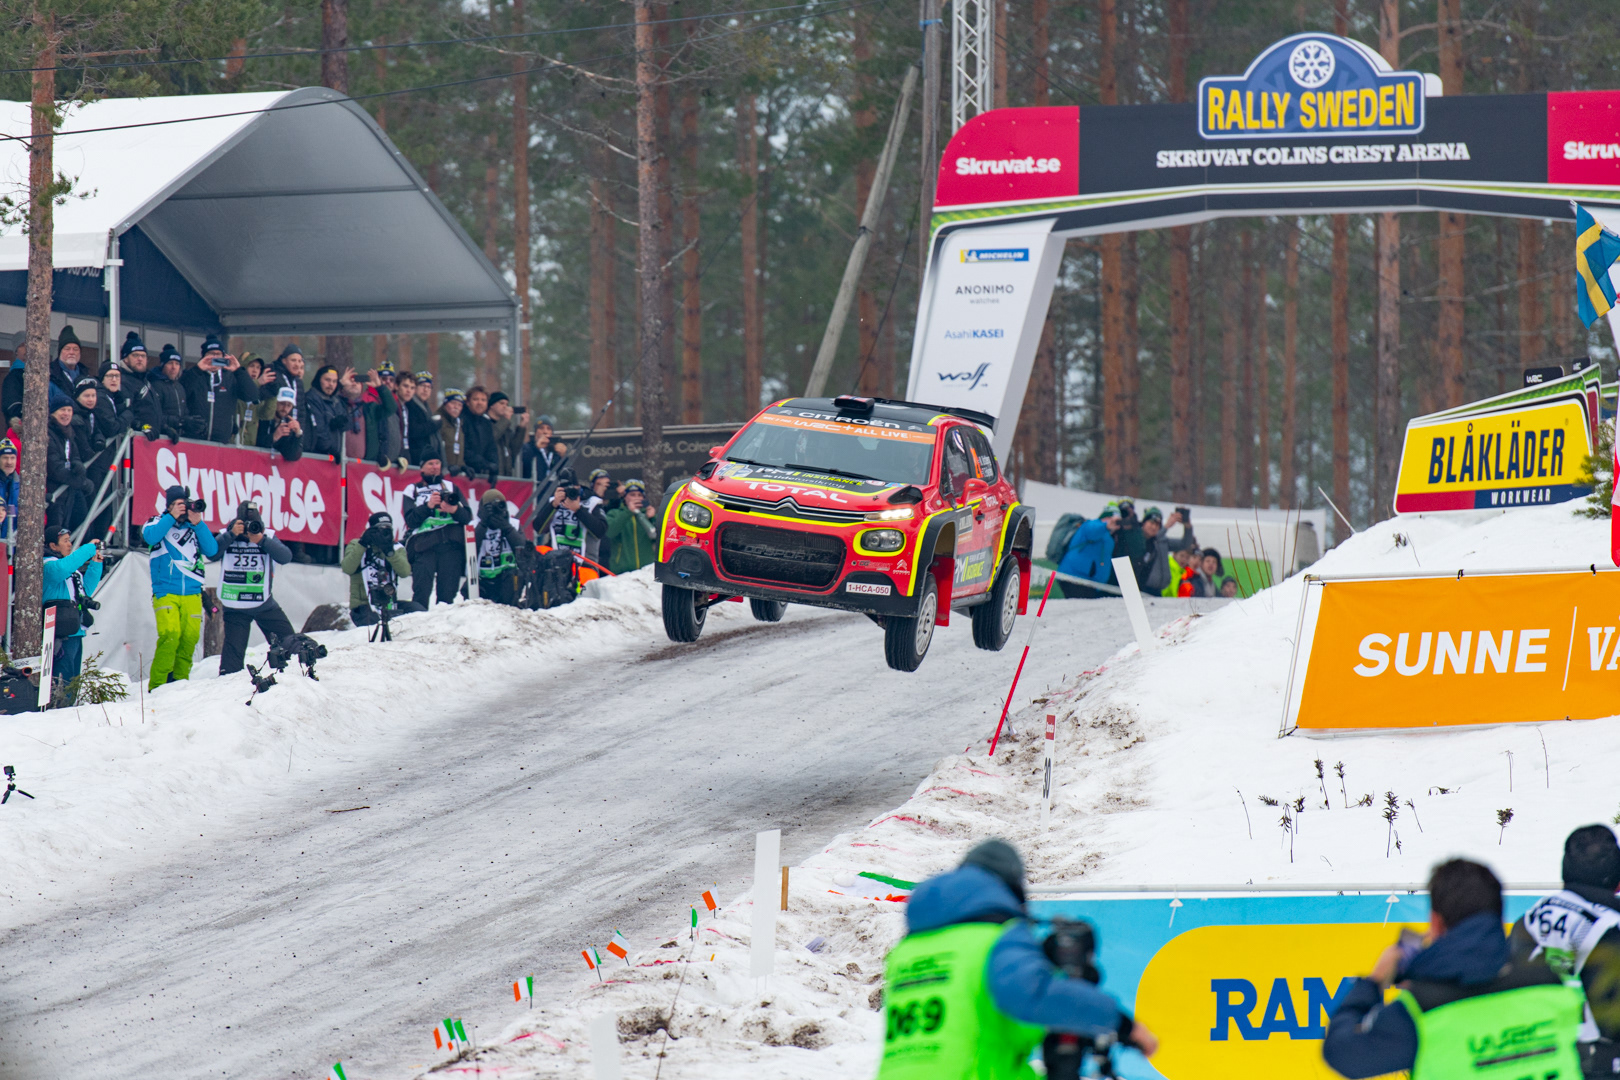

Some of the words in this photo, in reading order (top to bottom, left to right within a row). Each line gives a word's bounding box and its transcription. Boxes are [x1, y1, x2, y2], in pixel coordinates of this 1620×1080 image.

[1208, 86, 1291, 130] RALLY
[1299, 81, 1415, 129] SWEDEN
[1156, 149, 1251, 168] SKRUVAT
[1252, 146, 1328, 166] COLINS
[1328, 144, 1396, 164] CREST
[1396, 142, 1471, 162] ARENA
[955, 155, 1061, 176] Skruvat.se
[978, 251, 1025, 260] MICHELIN
[955, 284, 1014, 295] ANONIMO
[944, 328, 1004, 340] AsahiKASEI
[1526, 374, 1543, 383] WRC
[854, 427, 878, 436] ALL
[880, 431, 908, 439] LIVE
[582, 443, 623, 458] Olsson
[1428, 419, 1566, 485] BLÅKLÄDER
[156, 447, 325, 535] Skruvat.se
[744, 480, 848, 504] TOTAL
[1490, 487, 1552, 506] WORKWEAR
[234, 555, 258, 567] 235
[848, 584, 890, 595] 1-HCA-050
[1352, 628, 1551, 678] SUNNE
